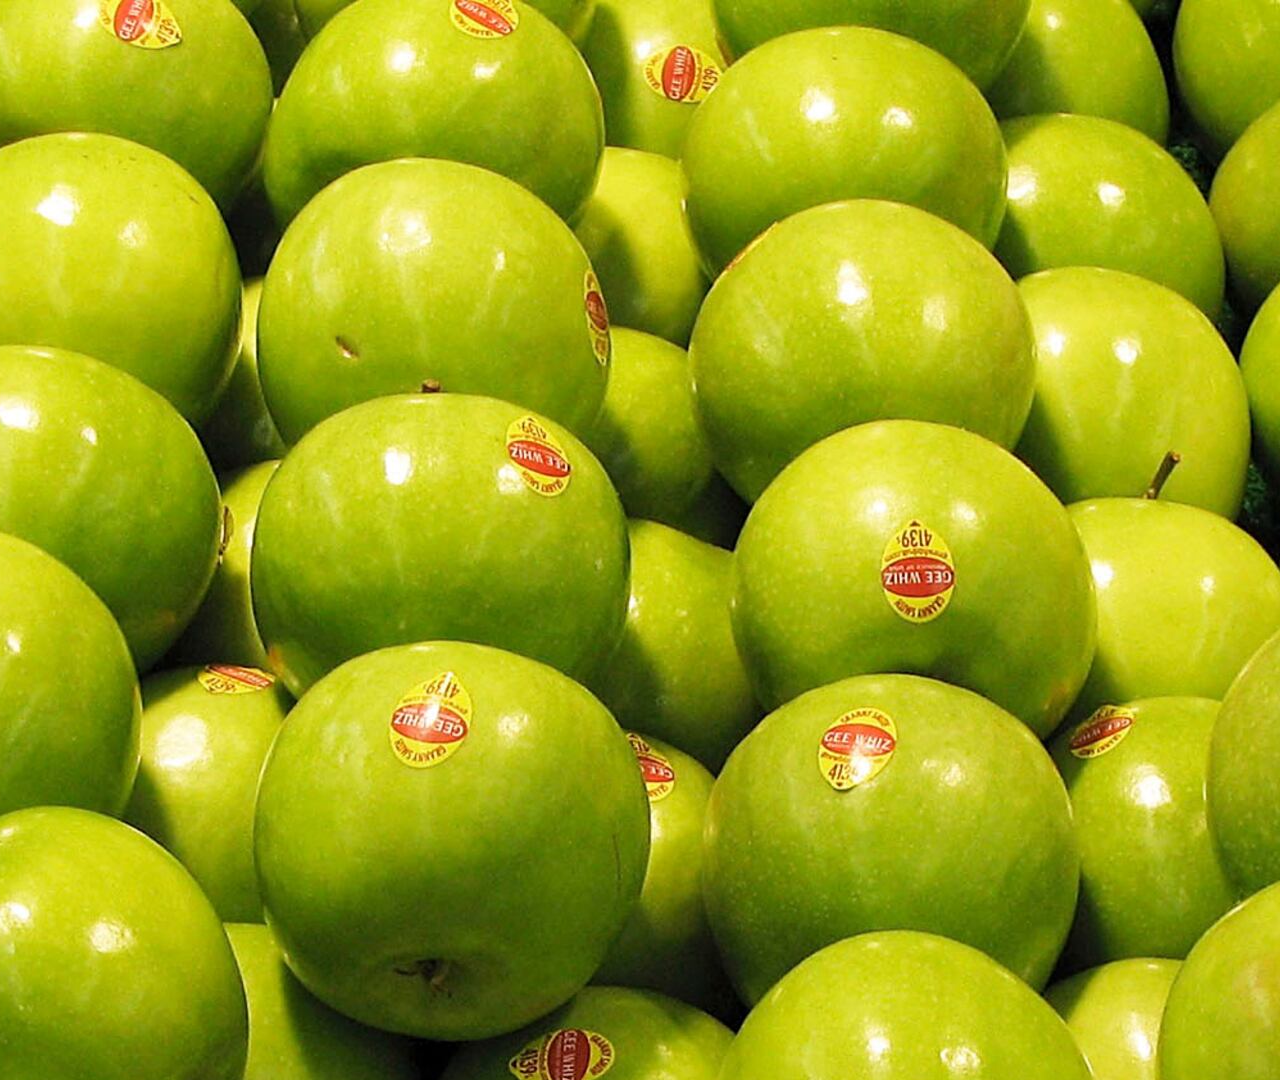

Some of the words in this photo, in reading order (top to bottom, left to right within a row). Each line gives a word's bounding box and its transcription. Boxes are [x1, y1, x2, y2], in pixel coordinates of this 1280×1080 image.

[120, 17, 139, 39] GEE
[673, 48, 688, 77] WHIZ
[669, 78, 683, 100] GEE
[701, 68, 719, 92] 4139
[510, 448, 545, 465] WHIZ
[547, 453, 569, 473] GEE
[901, 529, 933, 548] 4139
[884, 572, 922, 586] WHIZ
[925, 571, 952, 586] GEE
[433, 721, 465, 739] GEE
[823, 731, 850, 743] GEE
[853, 734, 891, 751] WHIZ
[562, 1031, 578, 1051] GEE
